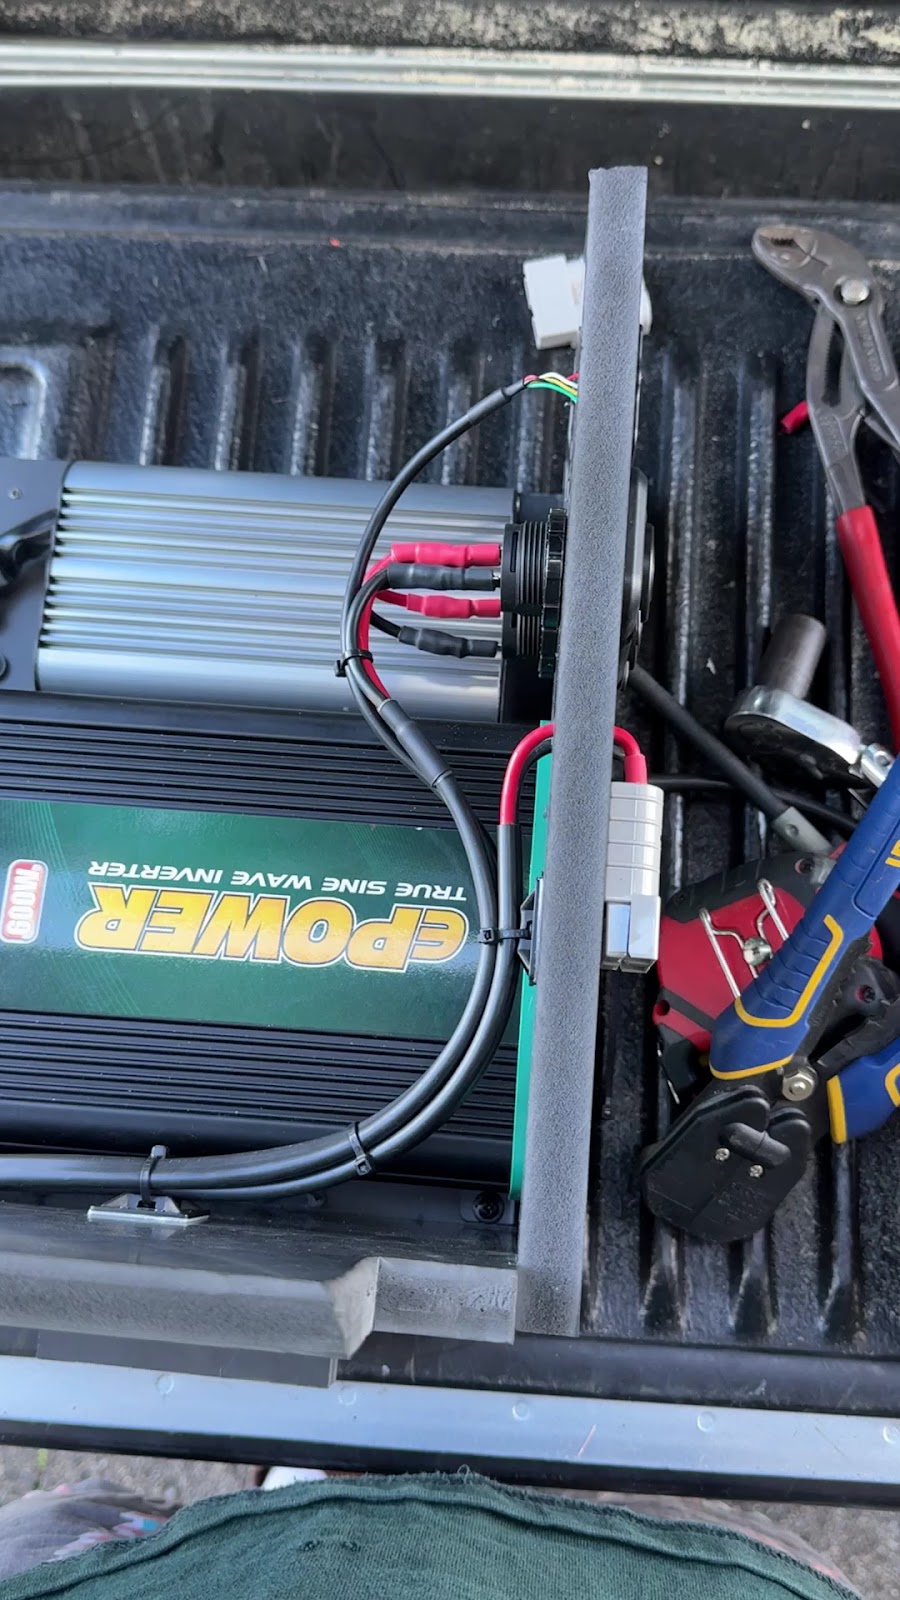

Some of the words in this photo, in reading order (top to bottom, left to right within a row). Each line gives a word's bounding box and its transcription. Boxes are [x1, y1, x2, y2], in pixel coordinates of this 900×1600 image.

[88, 861, 223, 885] INVERTER
[230, 870, 312, 891] WAVE
[321, 877, 387, 896] SINE
[394, 882, 467, 901] TRUE
[6, 867, 40, 936] 600W
